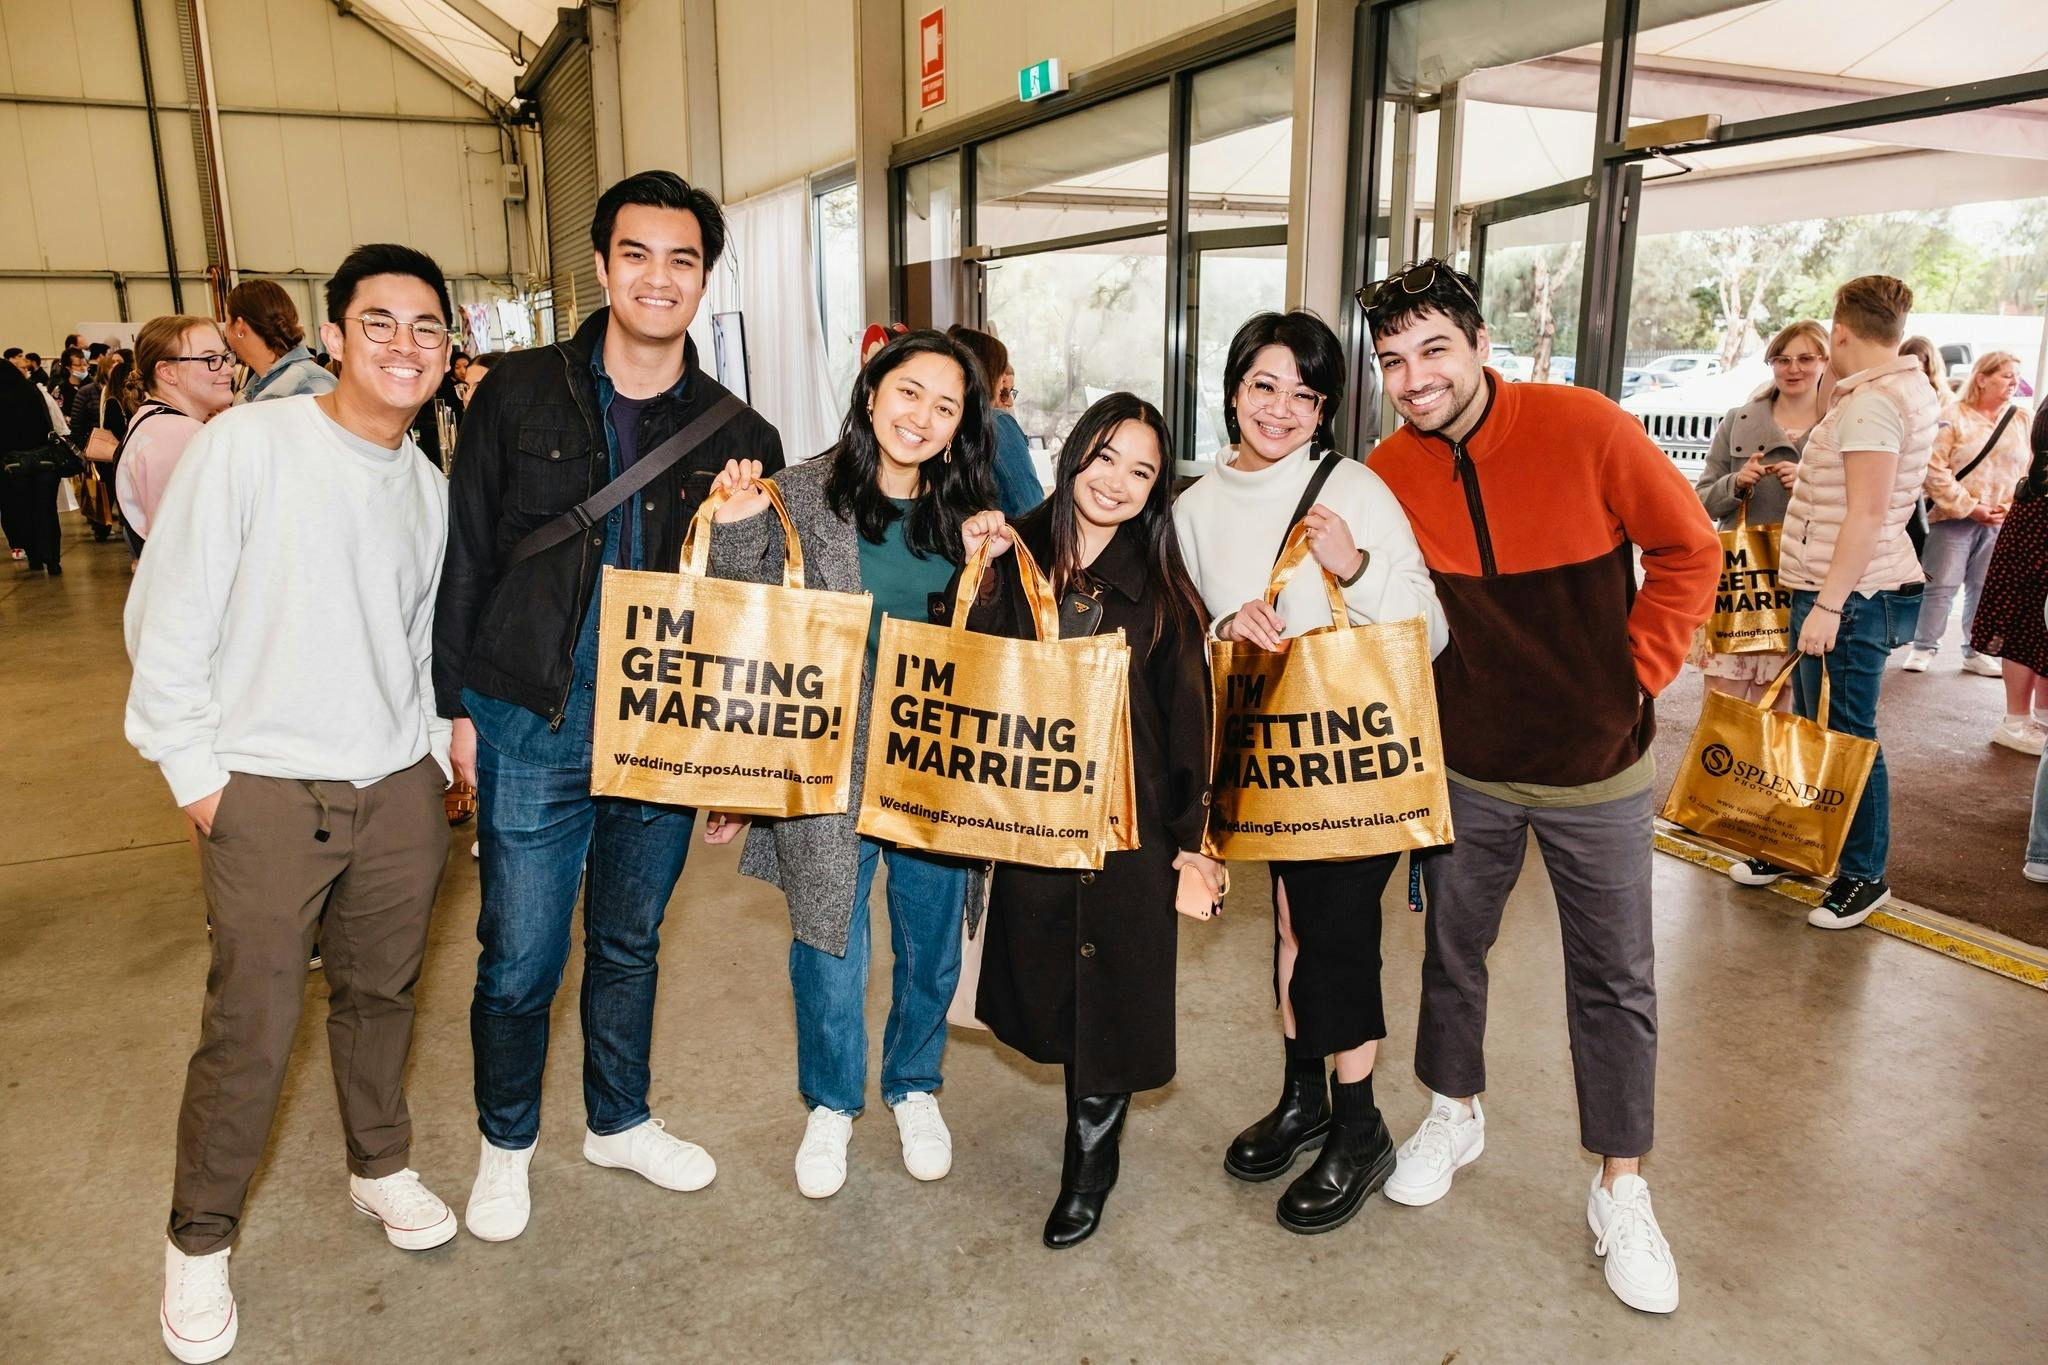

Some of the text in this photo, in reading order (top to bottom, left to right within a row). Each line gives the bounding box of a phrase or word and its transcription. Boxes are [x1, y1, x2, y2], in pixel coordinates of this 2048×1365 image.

[1715, 590, 1792, 614] MARR
[1717, 568, 1785, 592] GETT
[625, 605, 695, 645] I'M
[621, 646, 824, 700] GETTING
[895, 653, 956, 697] I'M
[1227, 674, 1266, 709] I'M
[618, 687, 843, 741] MARRIED!
[890, 694, 1076, 753] GETTING
[1224, 701, 1395, 750] GETTING
[614, 753, 834, 785] WeddingExposAustralia.com
[886, 732, 1097, 795] MARRIED!
[1220, 736, 1425, 790] MARRIED!
[1733, 760, 1845, 806] SPLENDID
[1734, 776, 1779, 799] PHOTOS
[879, 795, 1089, 839] WeddingExposAustralia.com
